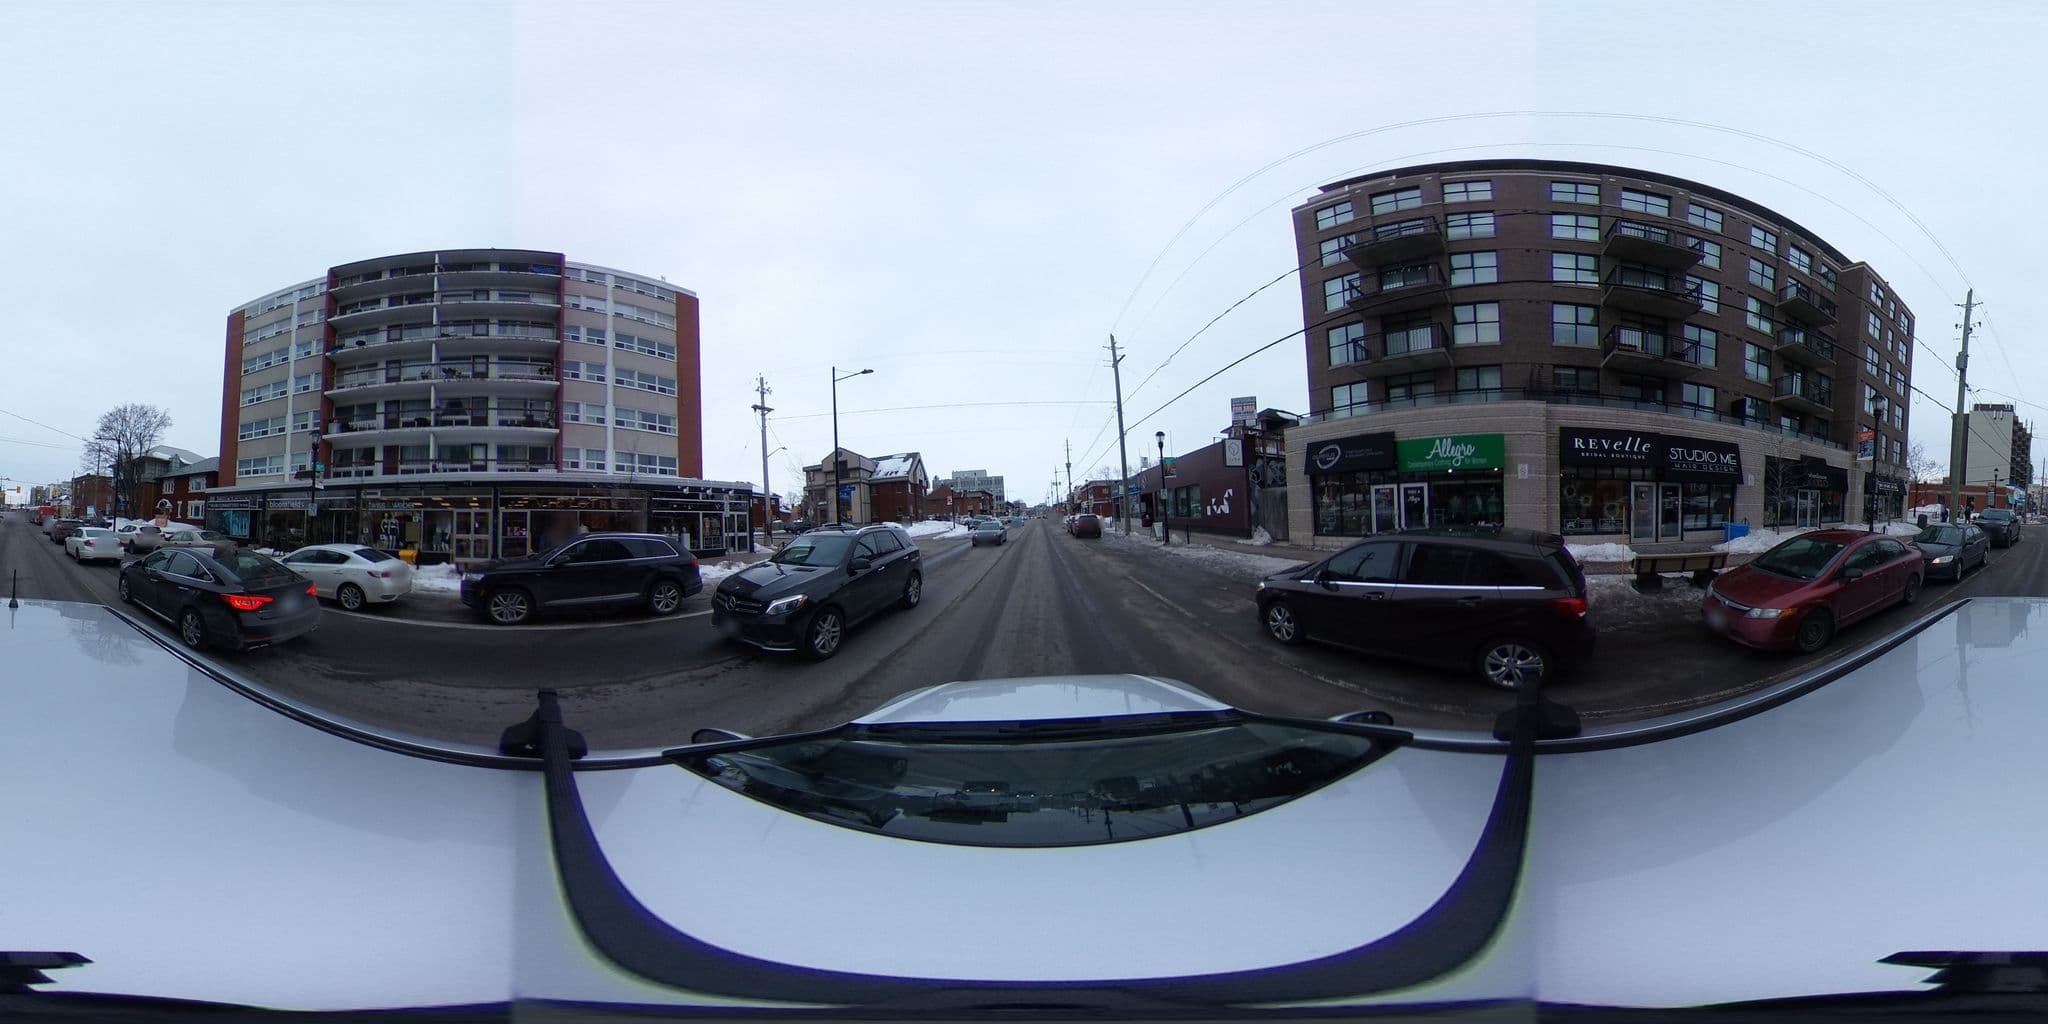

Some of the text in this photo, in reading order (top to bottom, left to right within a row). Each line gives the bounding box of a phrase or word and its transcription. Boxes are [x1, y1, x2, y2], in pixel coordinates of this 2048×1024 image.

[1425, 438, 1475, 466] Allegro
[1669, 447, 1737, 465] STUDIO ME
[1702, 464, 1735, 472] DESIGN
